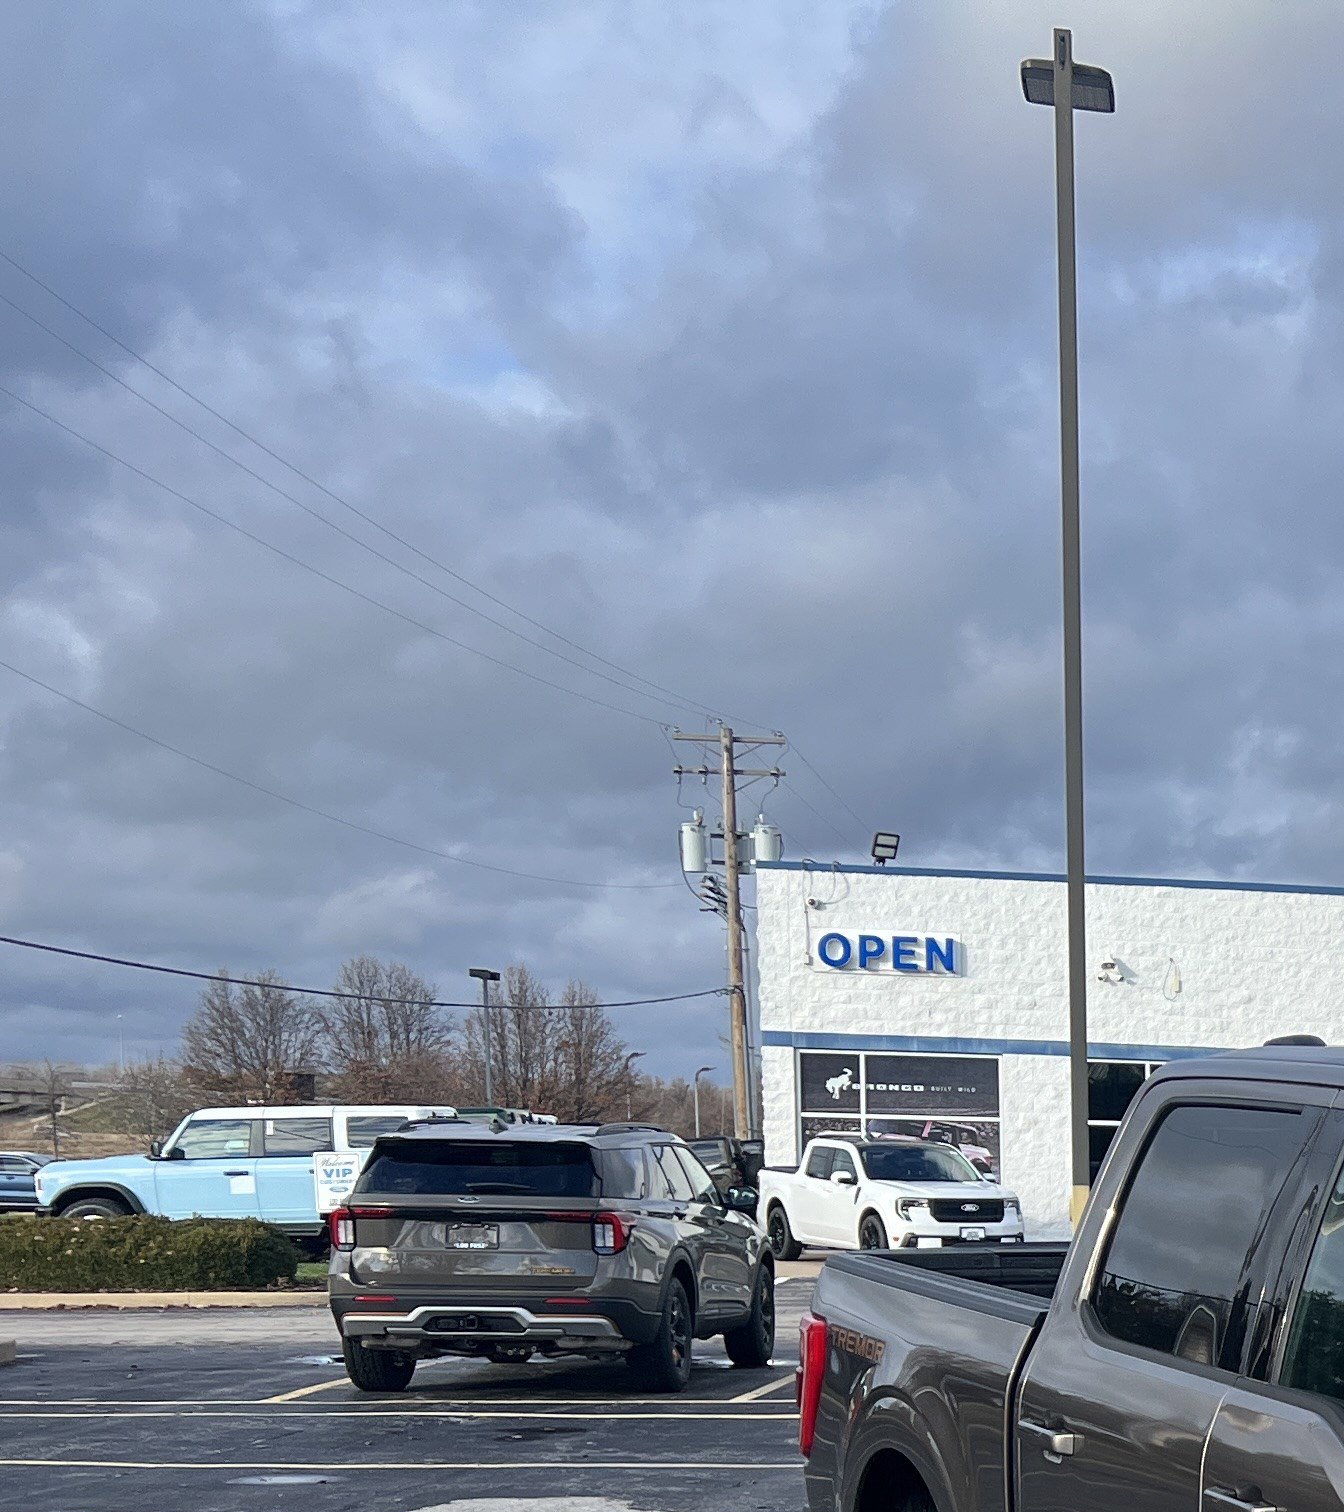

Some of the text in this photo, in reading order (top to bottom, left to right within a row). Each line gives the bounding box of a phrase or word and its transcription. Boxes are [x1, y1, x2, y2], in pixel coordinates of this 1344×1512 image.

[817, 933, 956, 972] OPEN
[322, 1168, 353, 1178] VIP
[831, 1325, 885, 1364] TREMOR
